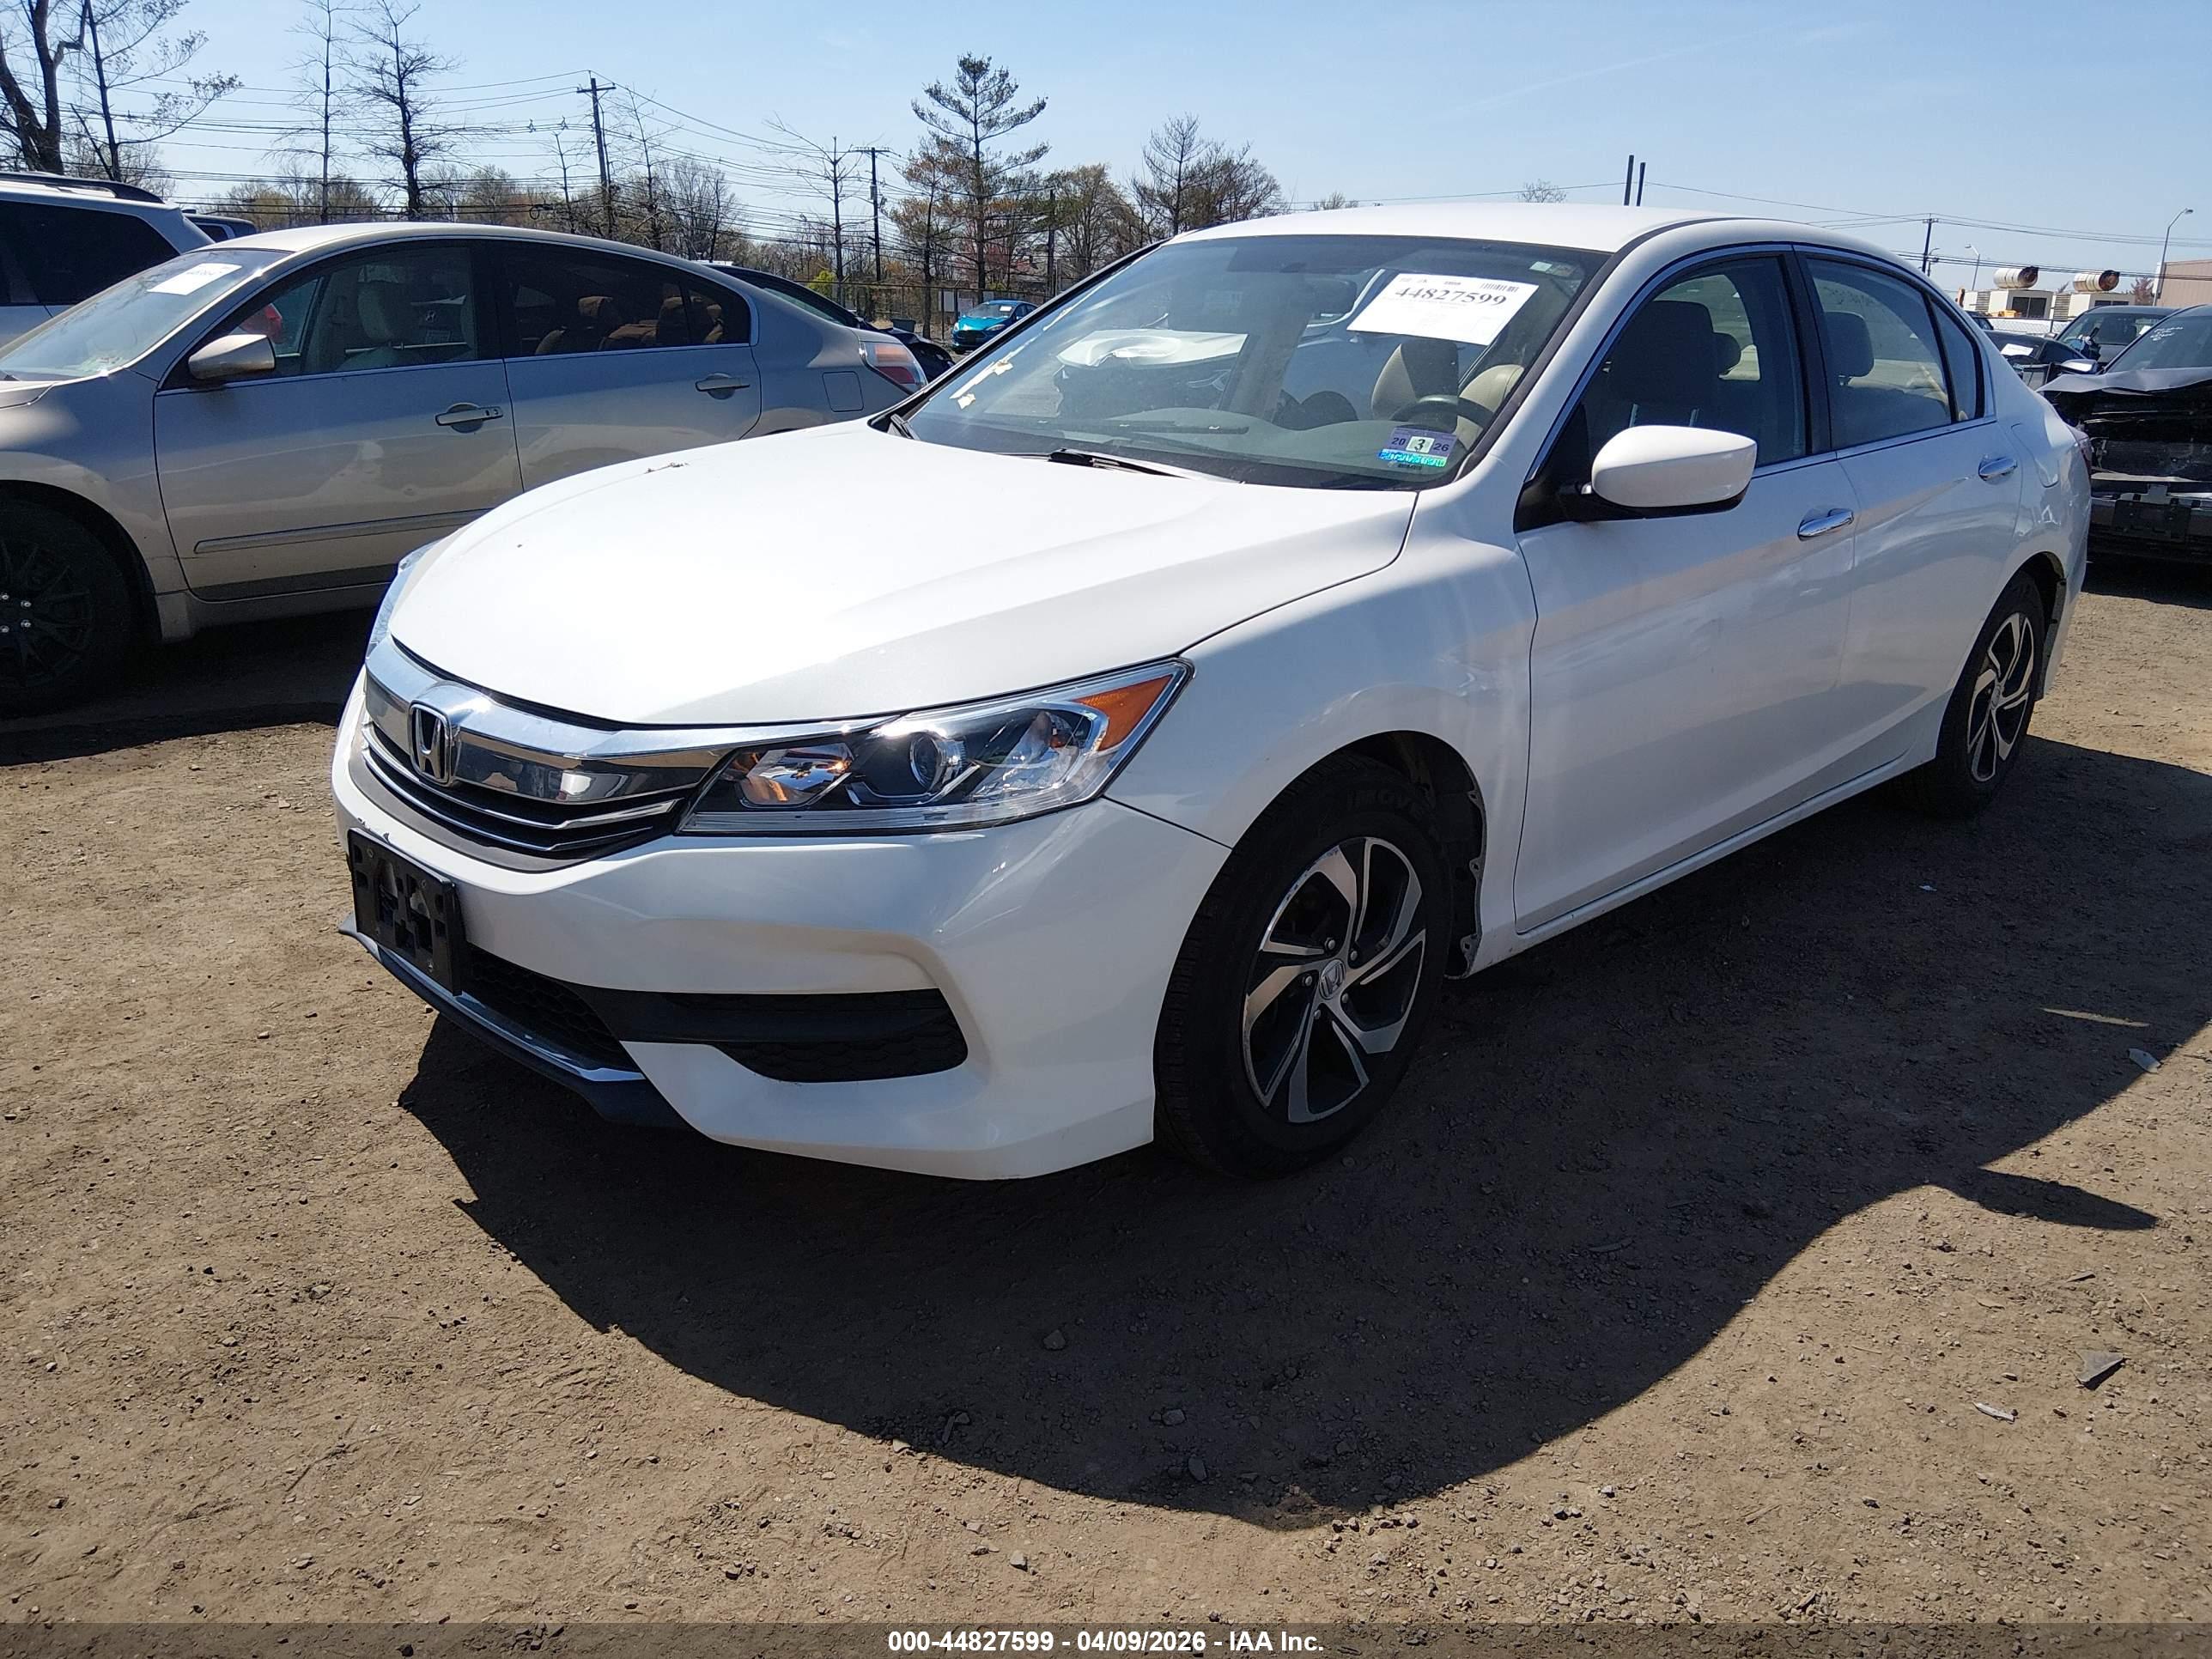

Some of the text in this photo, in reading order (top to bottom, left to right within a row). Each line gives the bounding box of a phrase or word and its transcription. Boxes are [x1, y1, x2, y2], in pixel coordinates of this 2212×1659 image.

[1395, 287, 1508, 306] 44827599
[1391, 437, 1449, 452] 20 3 26
